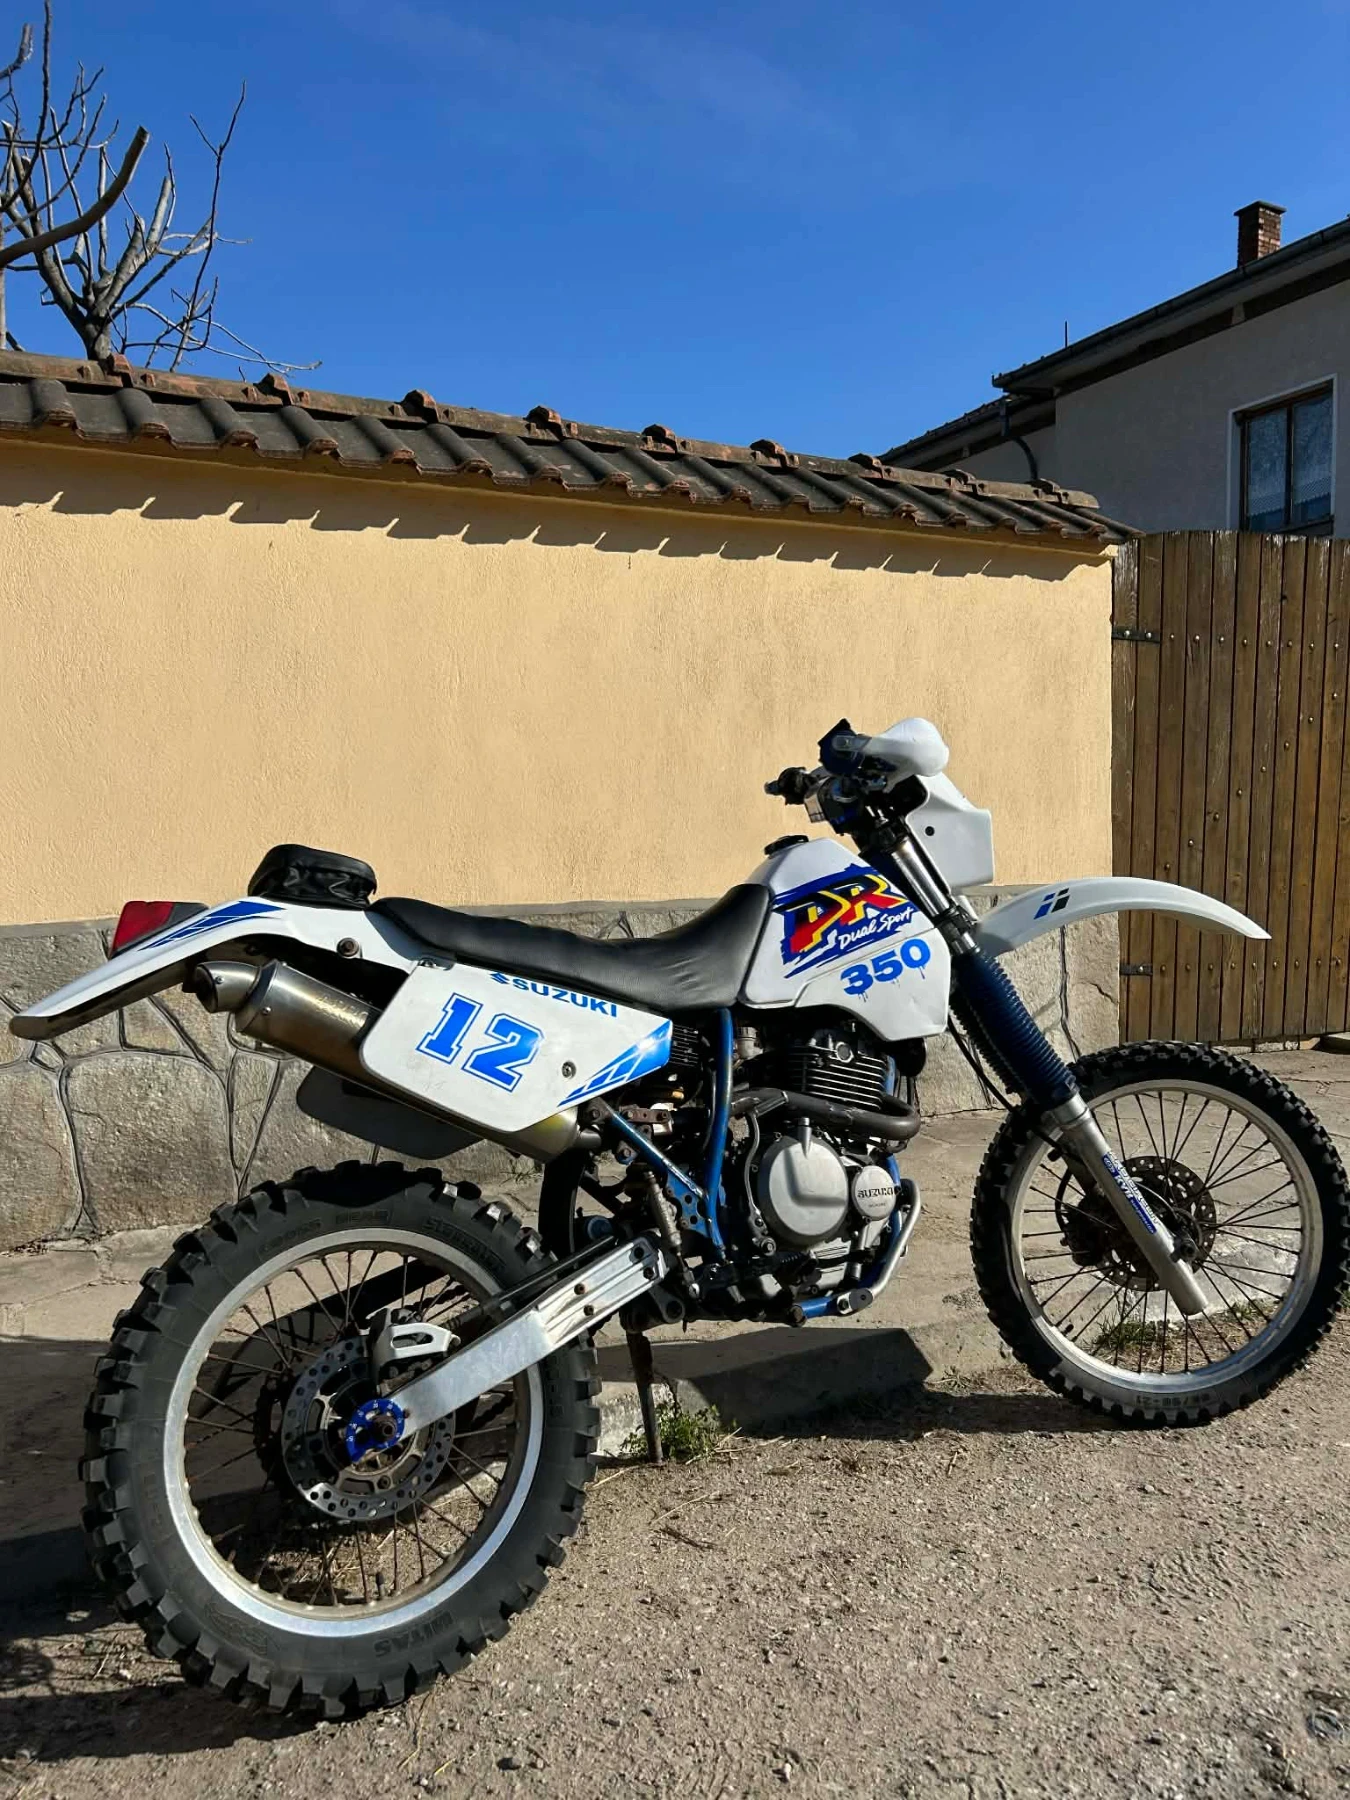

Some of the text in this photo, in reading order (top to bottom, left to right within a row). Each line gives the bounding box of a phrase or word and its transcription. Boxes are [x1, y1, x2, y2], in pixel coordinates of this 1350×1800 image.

[772, 874, 909, 953] DR
[837, 906, 914, 950] Dual Sport
[840, 938, 931, 996] 350
[510, 977, 618, 1018] SUZUKI
[416, 992, 545, 1092] 12
[857, 1187, 894, 1199] SUZUKI
